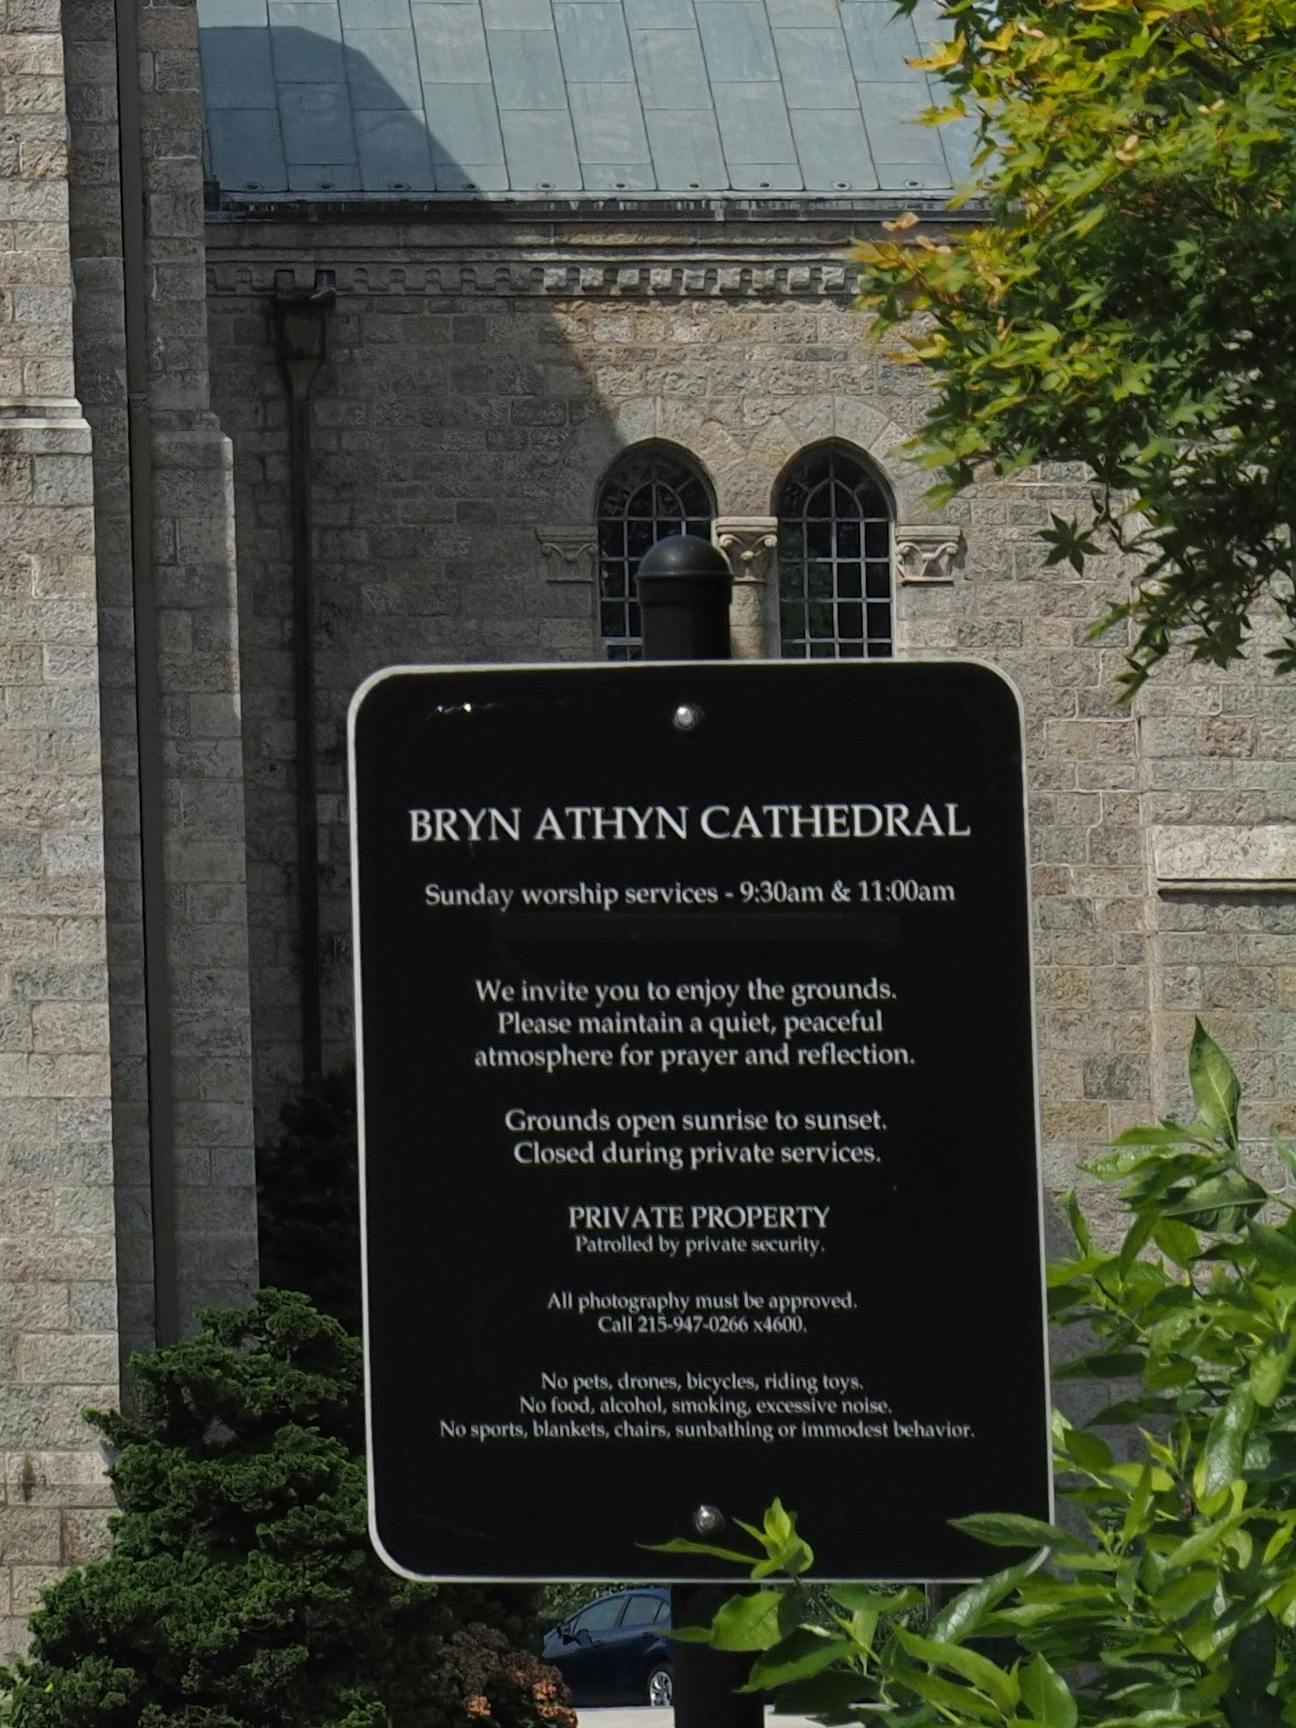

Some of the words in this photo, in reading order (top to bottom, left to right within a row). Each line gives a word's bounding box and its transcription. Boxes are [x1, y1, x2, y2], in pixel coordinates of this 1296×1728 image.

[408, 807, 522, 843] BRYN
[533, 805, 690, 841] ATHYN
[700, 802, 972, 840] CATHEDRAL
[424, 882, 514, 913] Sunday
[521, 881, 619, 912] worship
[624, 881, 719, 904] services
[739, 879, 825, 904] 9:30am
[830, 879, 852, 903] &
[858, 879, 956, 902] 11:00am
[475, 979, 515, 1003] We
[521, 979, 589, 1002] invite
[594, 984, 641, 1009] you
[647, 981, 671, 1001] to
[675, 978, 741, 1008] enjoy
[747, 977, 786, 1001] the
[791, 976, 897, 1008] grounds.
[497, 1010, 573, 1035] Please
[578, 1010, 684, 1034] maintain
[689, 1016, 703, 1034] a
[709, 1010, 777, 1040] quiet,
[783, 1008, 883, 1040] peaceful
[474, 1042, 614, 1074] atmosphere
[619, 1042, 655, 1067] for
[660, 1048, 739, 1073] prayer
[744, 1041, 790, 1066] and
[797, 1041, 915, 1066] reflection.
[504, 1108, 611, 1132] Grounds
[616, 1113, 677, 1139] open
[682, 1108, 769, 1131] sunrise
[774, 1110, 799, 1131] to
[804, 1109, 888, 1131] sunset.
[513, 1140, 596, 1164] Closed
[601, 1140, 684, 1171] during
[689, 1140, 775, 1171] private
[780, 1140, 881, 1164] services.
[568, 1205, 685, 1229] PRIVATE
[690, 1205, 831, 1229] PROPERTY
[575, 1234, 654, 1253] Patrolled
[658, 1234, 680, 1258] by
[685, 1235, 748, 1258] private
[751, 1235, 825, 1257] security.
[547, 1291, 573, 1310] All
[577, 1291, 690, 1315] photography
[695, 1293, 740, 1310] must
[743, 1291, 765, 1310] be
[768, 1290, 858, 1315] approved.
[597, 1315, 633, 1333] Call
[637, 1314, 749, 1333] 215-947-0266
[753, 1315, 807, 1333] x4600.
[541, 1371, 569, 1390] No
[572, 1374, 613, 1395] pets,
[617, 1371, 682, 1392] drones,
[686, 1371, 760, 1395] bicycles,
[764, 1371, 819, 1395] riding
[822, 1374, 864, 1395] toys.
[519, 1395, 547, 1414] No
[550, 1395, 596, 1415] food,
[599, 1395, 668, 1416] alcohol,
[671, 1395, 752, 1419] smoking,
[755, 1397, 838, 1414] excessive
[841, 1396, 892, 1414] noise.
[439, 1419, 467, 1438] No
[470, 1421, 528, 1443] sports,
[532, 1419, 610, 1439] blankets,
[613, 1419, 671, 1439] chairs,
[675, 1419, 775, 1443] sunbathing
[777, 1424, 798, 1438] or
[801, 1419, 889, 1438] immodest
[893, 1419, 975, 1438] behavior.
